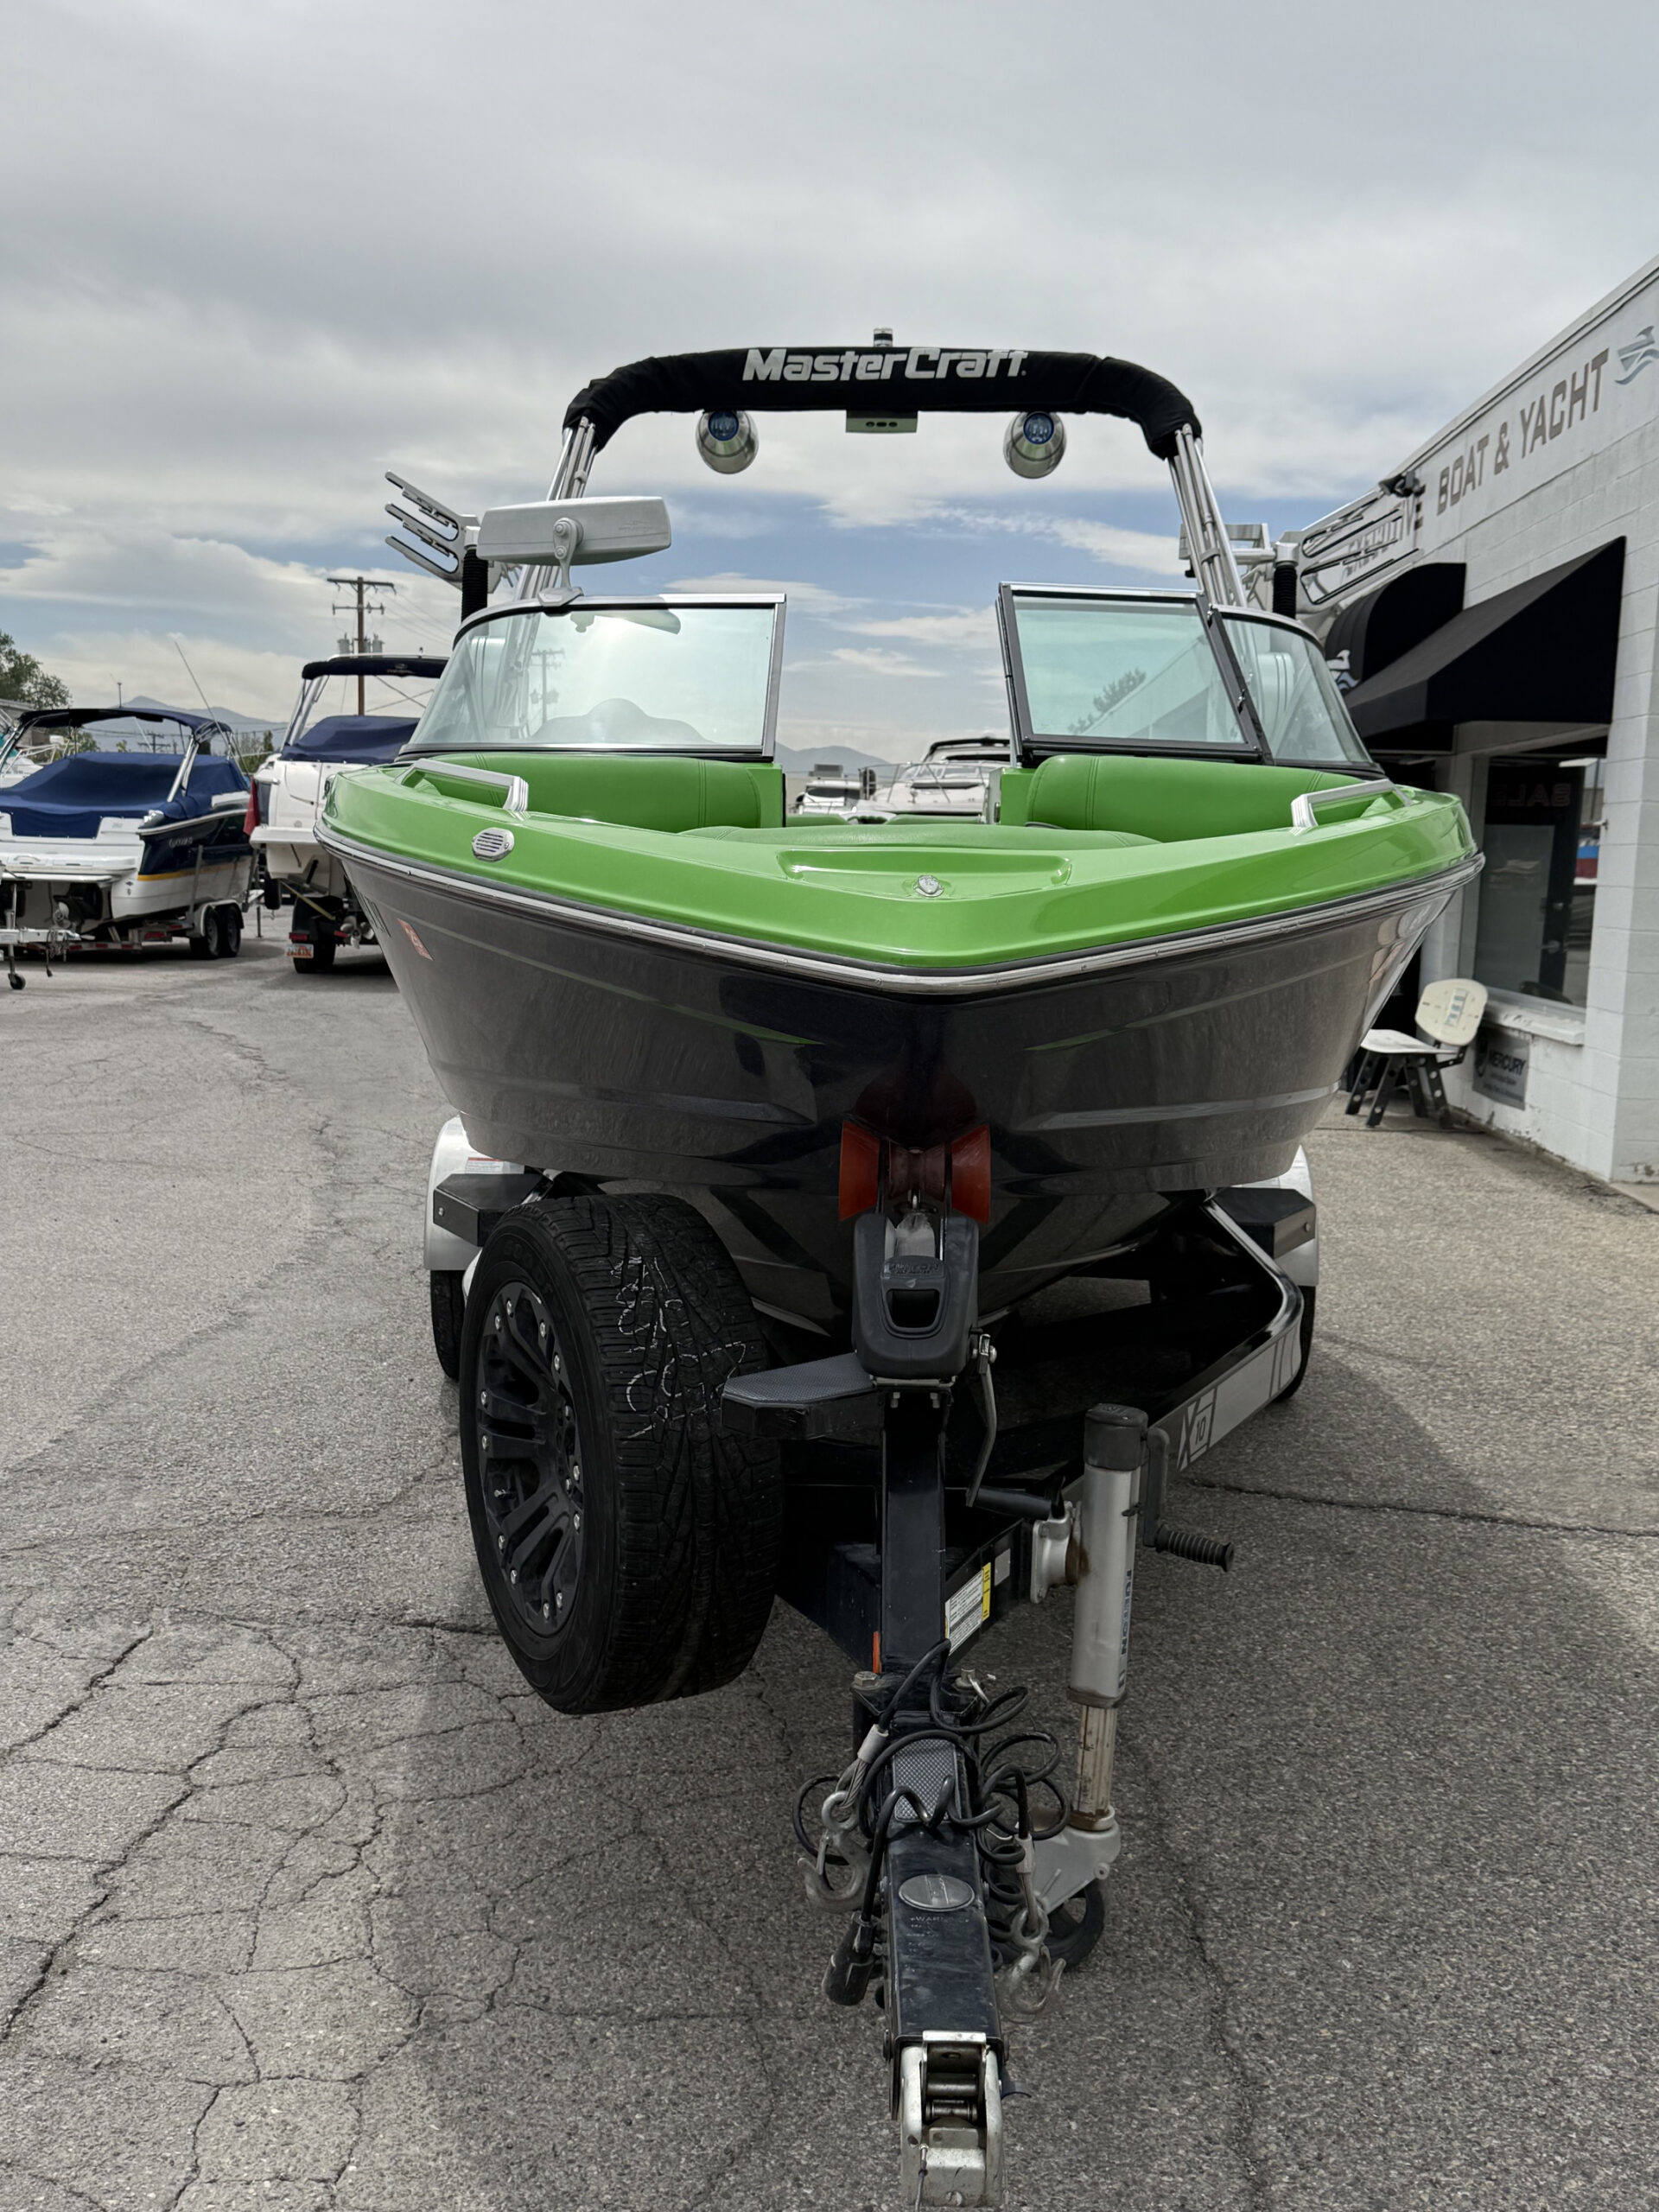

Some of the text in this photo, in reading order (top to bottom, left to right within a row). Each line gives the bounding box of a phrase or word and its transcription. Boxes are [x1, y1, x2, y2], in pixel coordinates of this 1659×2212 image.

[742, 347, 1028, 381] MasterCraft
[1437, 434, 1490, 517] BOAT
[1493, 421, 1510, 475] &
[1520, 347, 1610, 459] YACHT
[1121, 1569, 1132, 1656] FULTON
